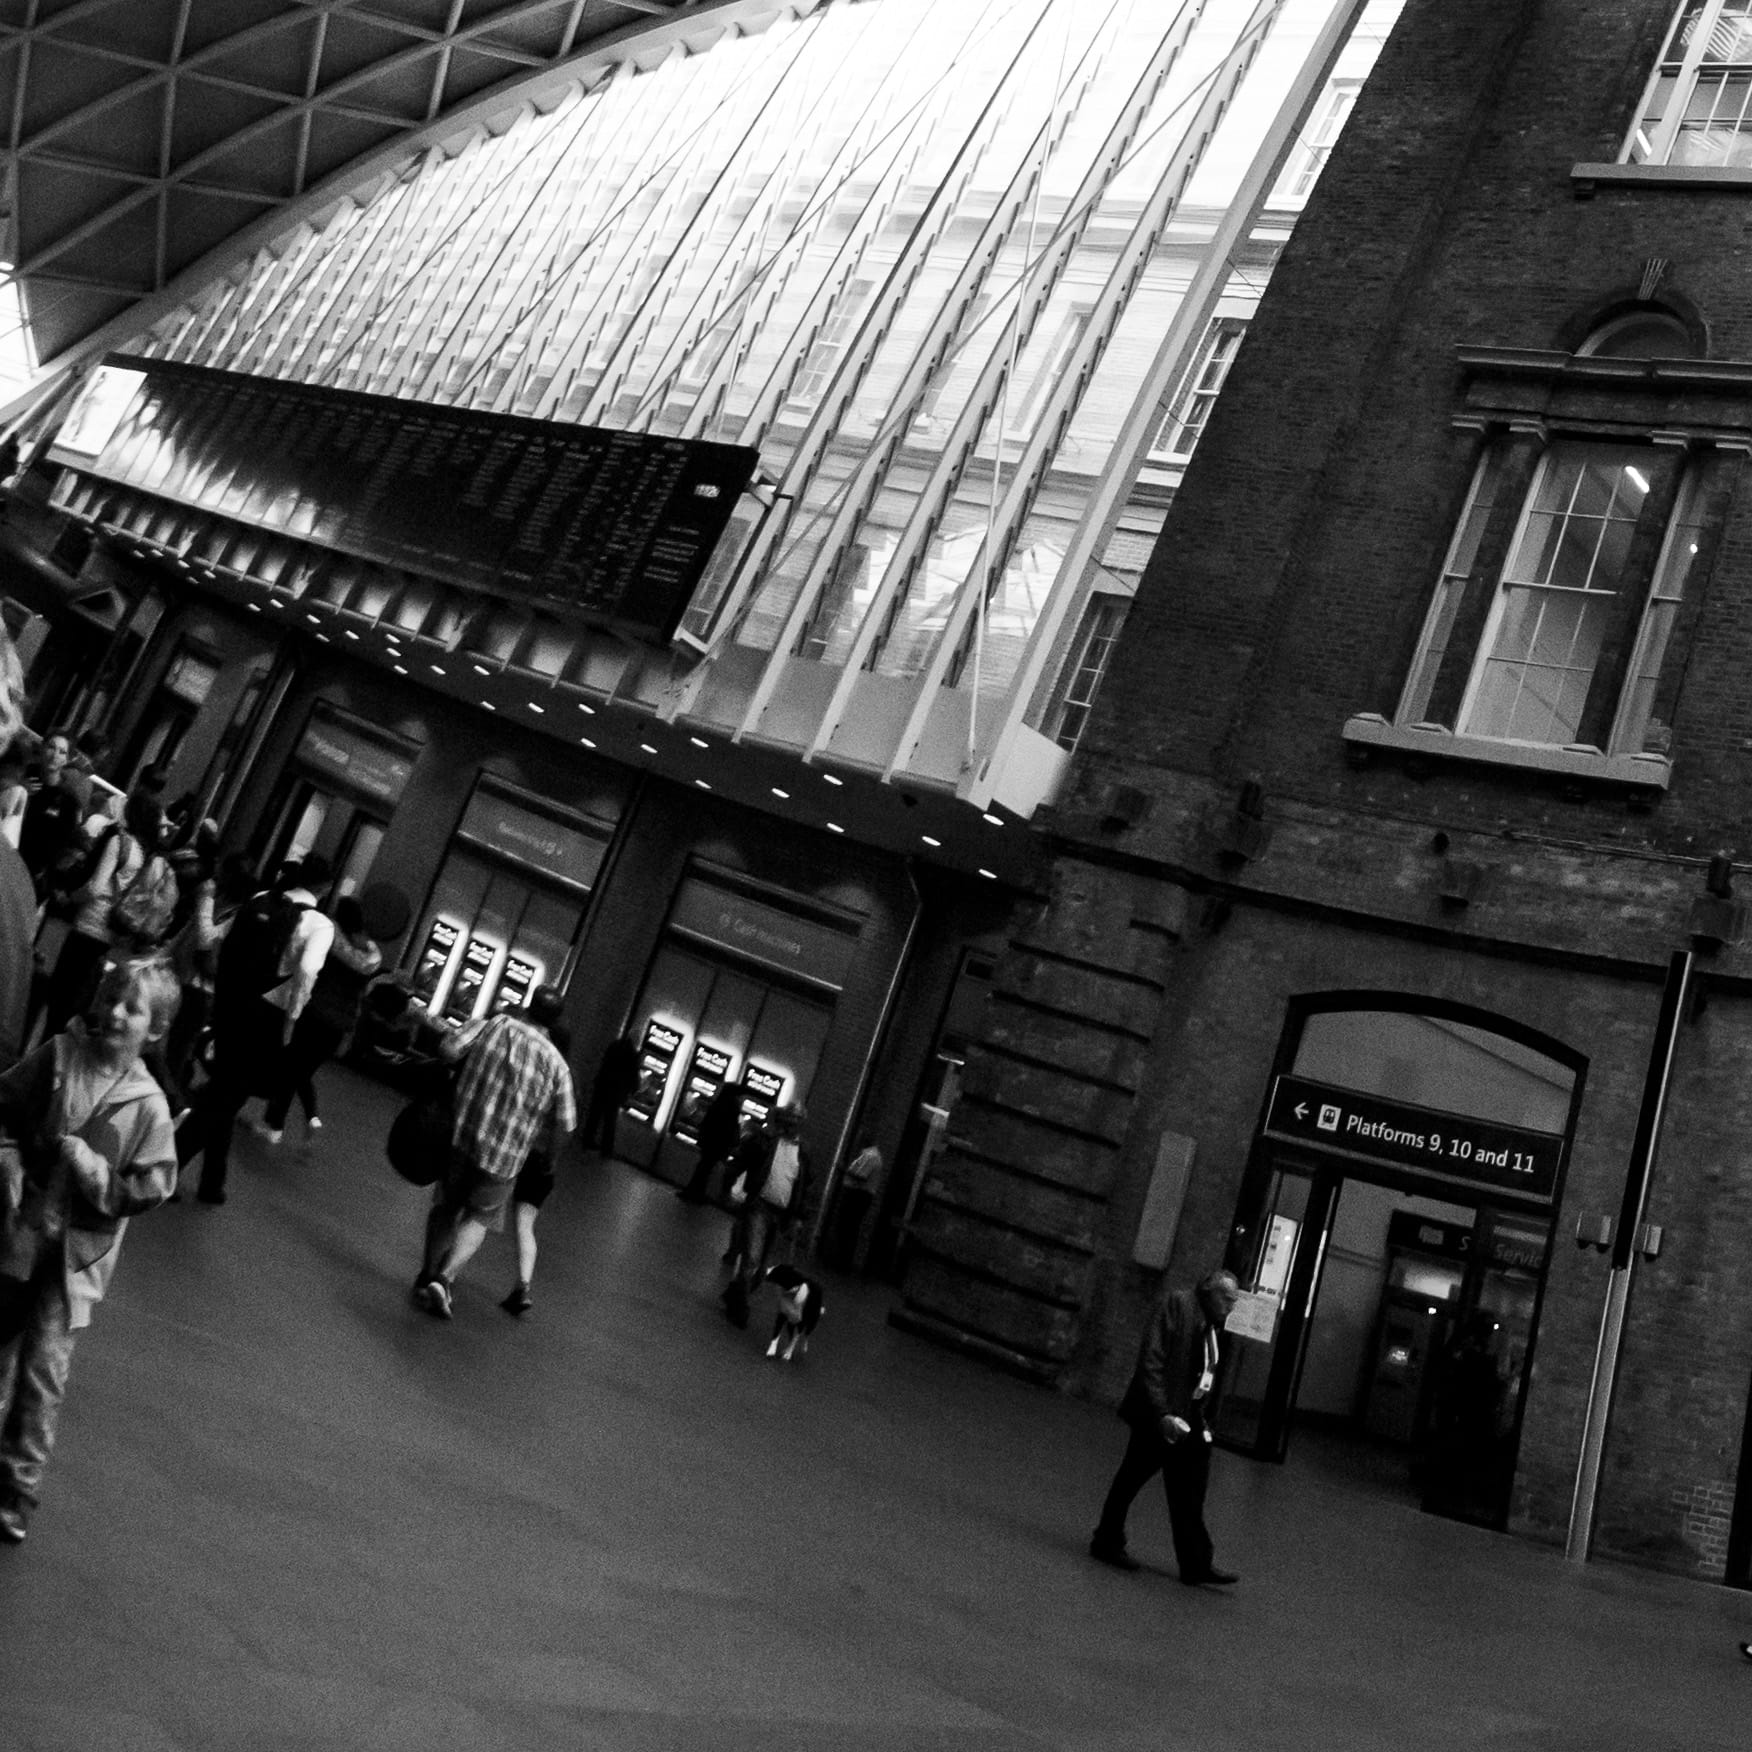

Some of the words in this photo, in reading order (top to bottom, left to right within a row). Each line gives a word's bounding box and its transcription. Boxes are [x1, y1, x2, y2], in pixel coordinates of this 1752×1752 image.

[1346, 1114, 1425, 1149] Platforms
[1429, 1133, 1444, 1155] 9,
[1449, 1138, 1472, 1160] 10
[1474, 1149, 1509, 1168] and
[1512, 1152, 1536, 1174] 11
